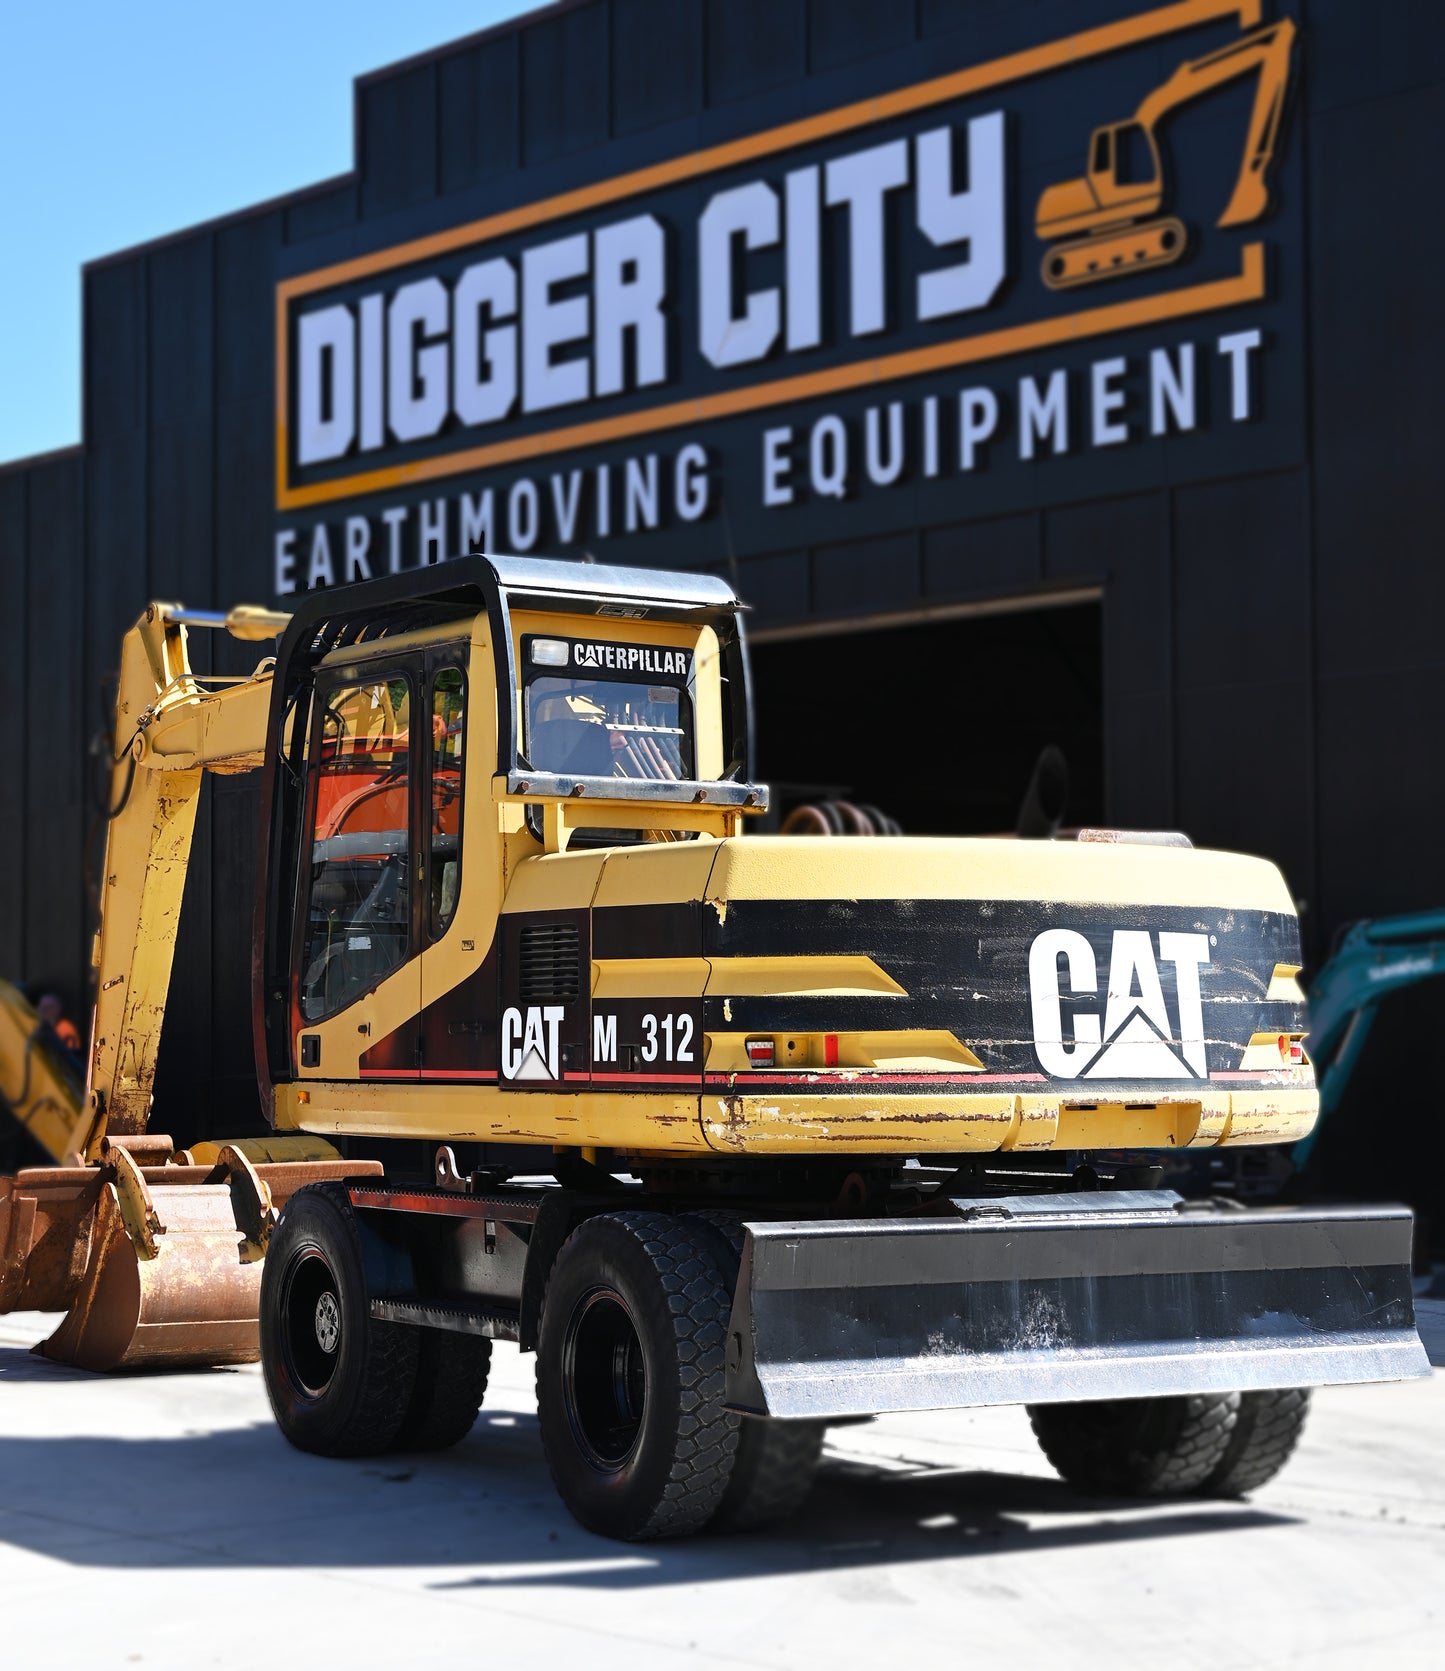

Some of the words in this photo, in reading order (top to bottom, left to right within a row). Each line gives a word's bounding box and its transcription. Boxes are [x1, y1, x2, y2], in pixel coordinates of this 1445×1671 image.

[297, 213, 667, 466] DIGGER
[698, 110, 1006, 369] CITY
[275, 443, 708, 595] EARTHMOVING
[762, 329, 1262, 506] EQUIPMENT
[574, 643, 687, 674] CATERPILLAR
[502, 1006, 564, 1080] CAT
[593, 1015, 617, 1062] M
[641, 1013, 694, 1062] 312
[1028, 928, 1211, 1079] CAT
